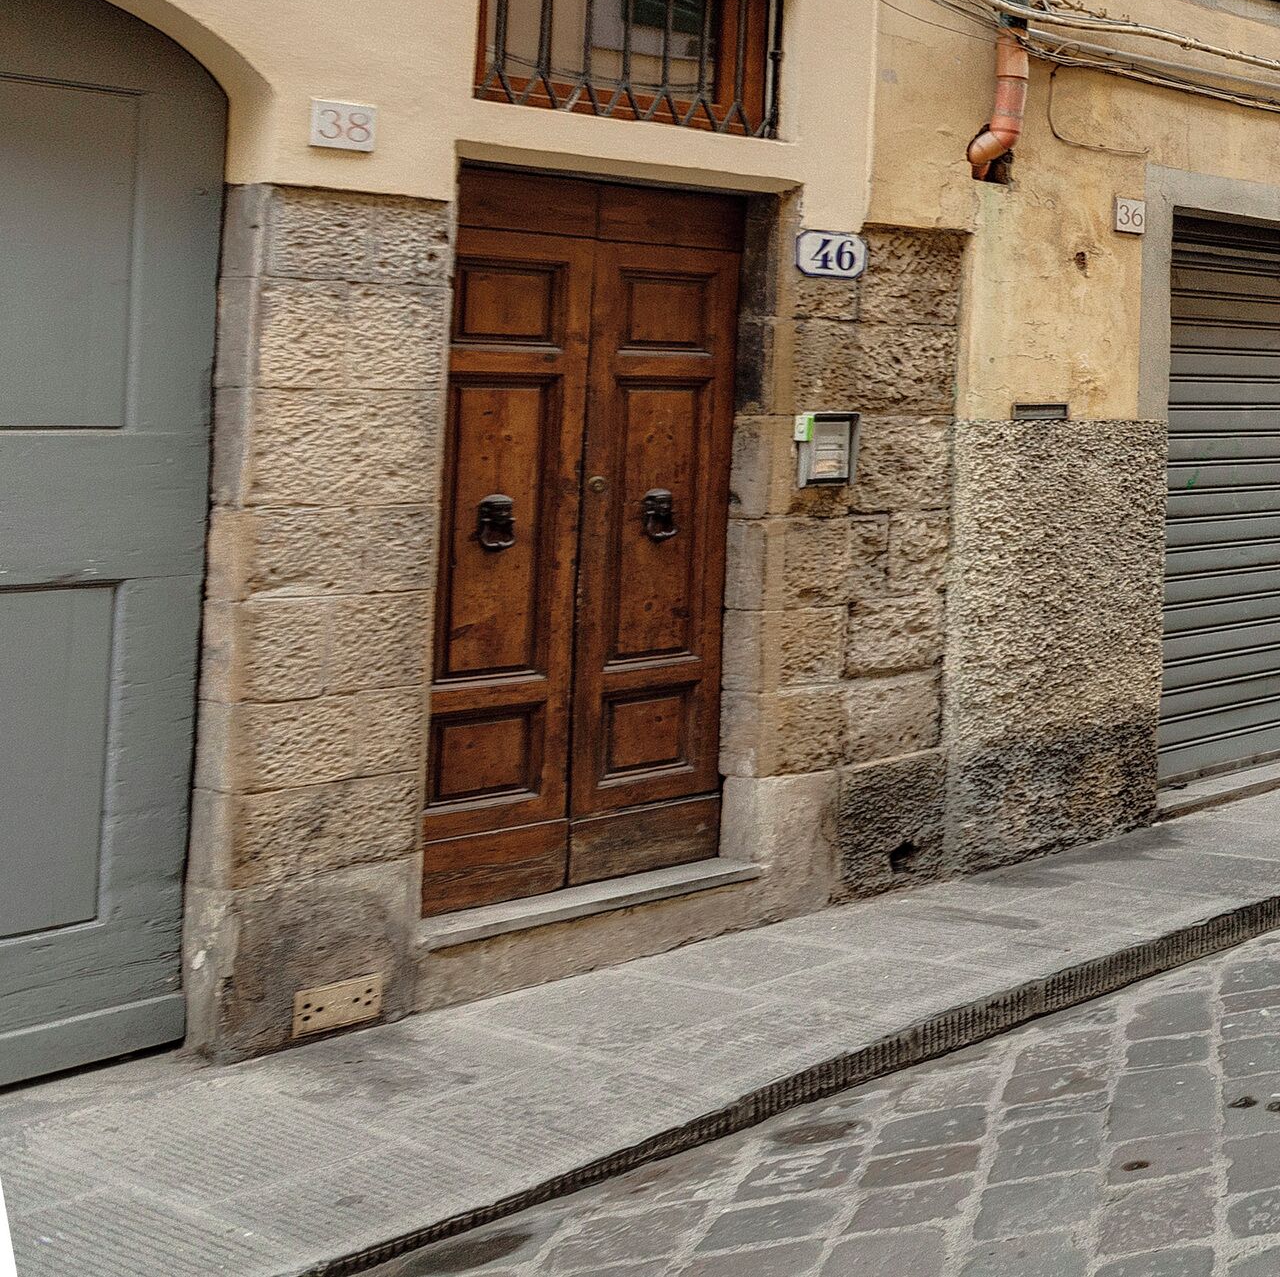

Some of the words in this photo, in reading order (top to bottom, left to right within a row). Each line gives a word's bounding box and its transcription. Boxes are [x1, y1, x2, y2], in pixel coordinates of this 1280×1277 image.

[318, 109, 371, 143] 38
[1118, 204, 1143, 227] 36
[810, 238, 856, 271] 46
